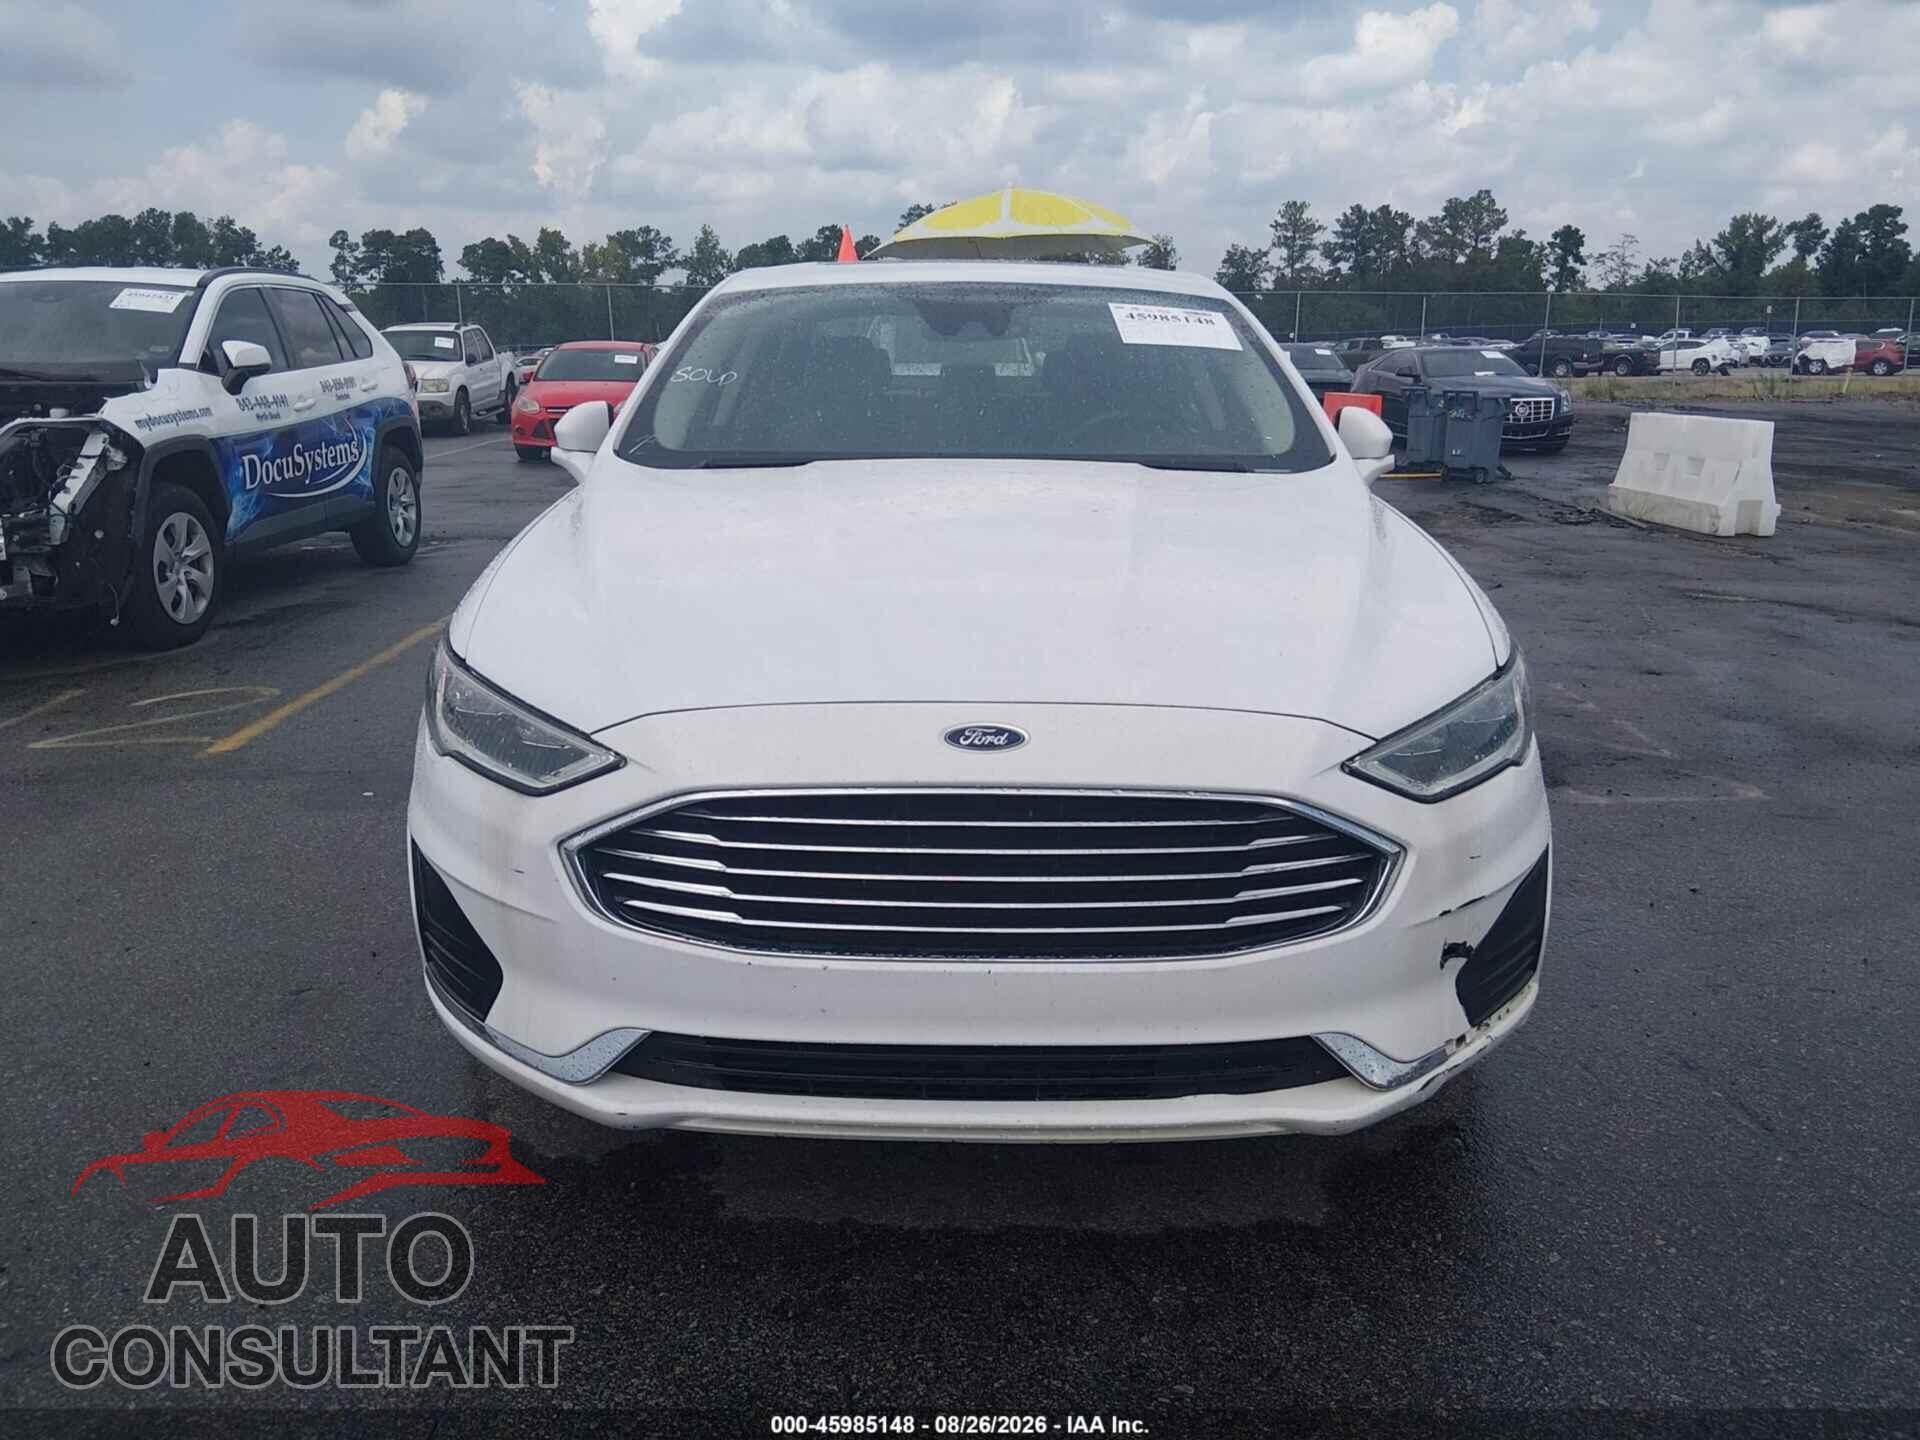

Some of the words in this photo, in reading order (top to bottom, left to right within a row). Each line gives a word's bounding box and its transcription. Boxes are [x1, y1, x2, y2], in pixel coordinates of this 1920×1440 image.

[670, 366, 738, 386] SOLD
[242, 440, 360, 490] DocuSystems
[959, 727, 1009, 745] Ford
